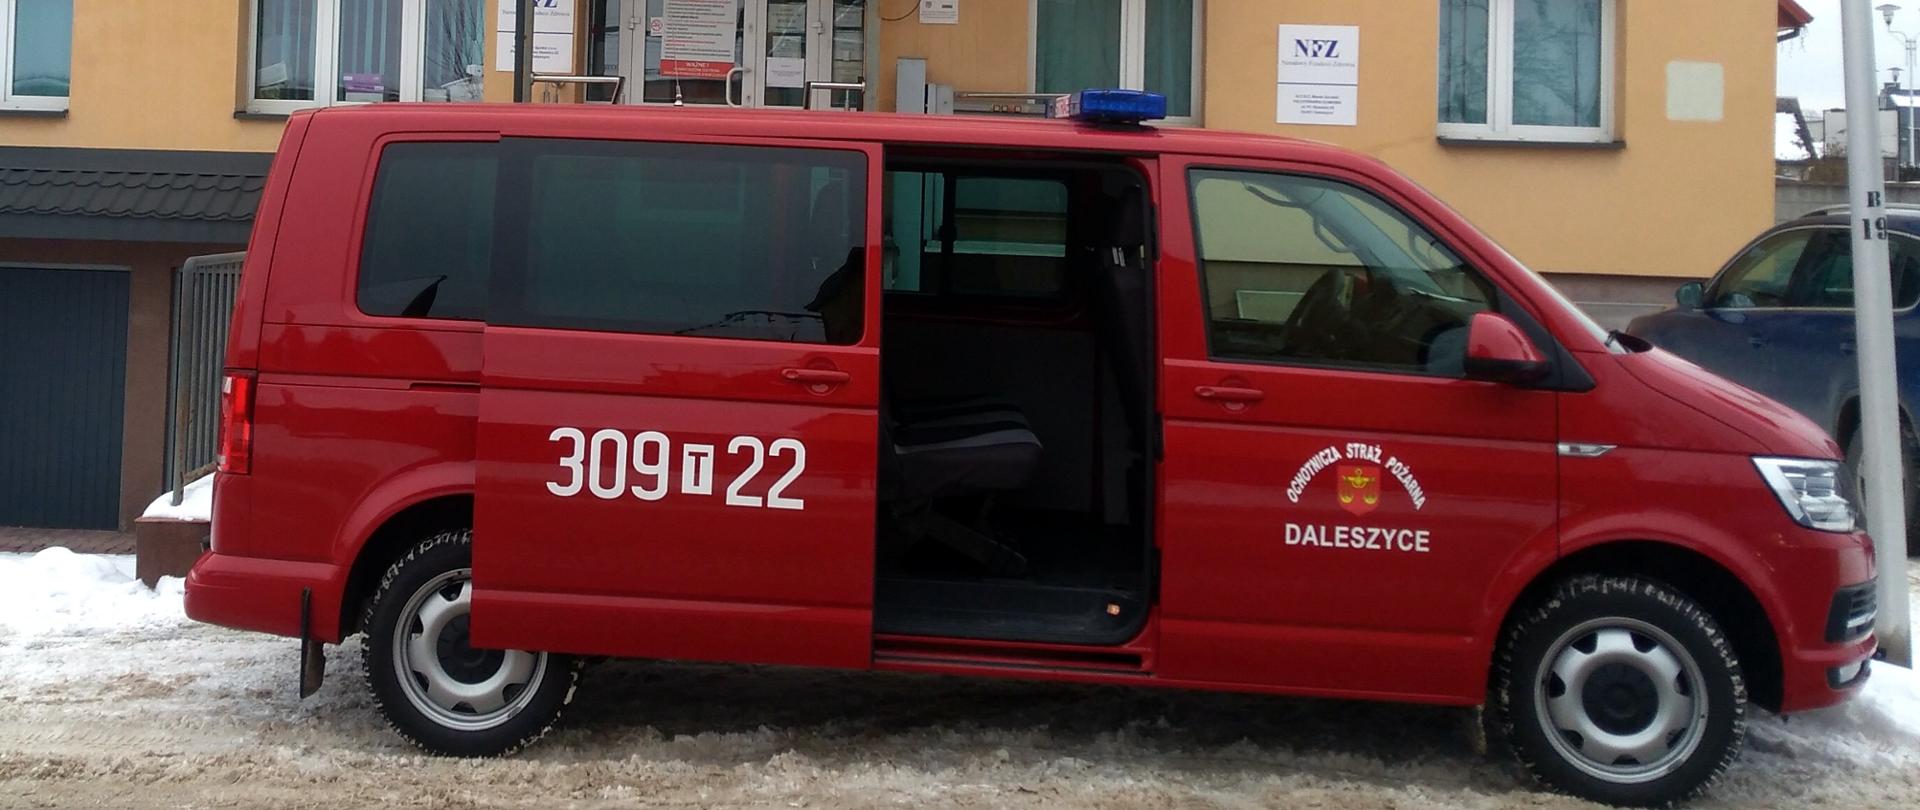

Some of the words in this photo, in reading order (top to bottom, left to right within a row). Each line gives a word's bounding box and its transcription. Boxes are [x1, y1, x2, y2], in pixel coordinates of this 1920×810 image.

[1294, 39, 1340, 58] NFZ
[1867, 191, 1881, 207] B
[1862, 217, 1887, 240] 19
[546, 427, 670, 501] 309
[686, 449, 710, 489] T
[725, 435, 806, 510] 22
[1286, 446, 1342, 503] OCHOTNICZA
[1346, 443, 1382, 464] STRAŻ
[1385, 456, 1426, 510] POŻARNA
[1285, 523, 1430, 552] DALESZYCE
